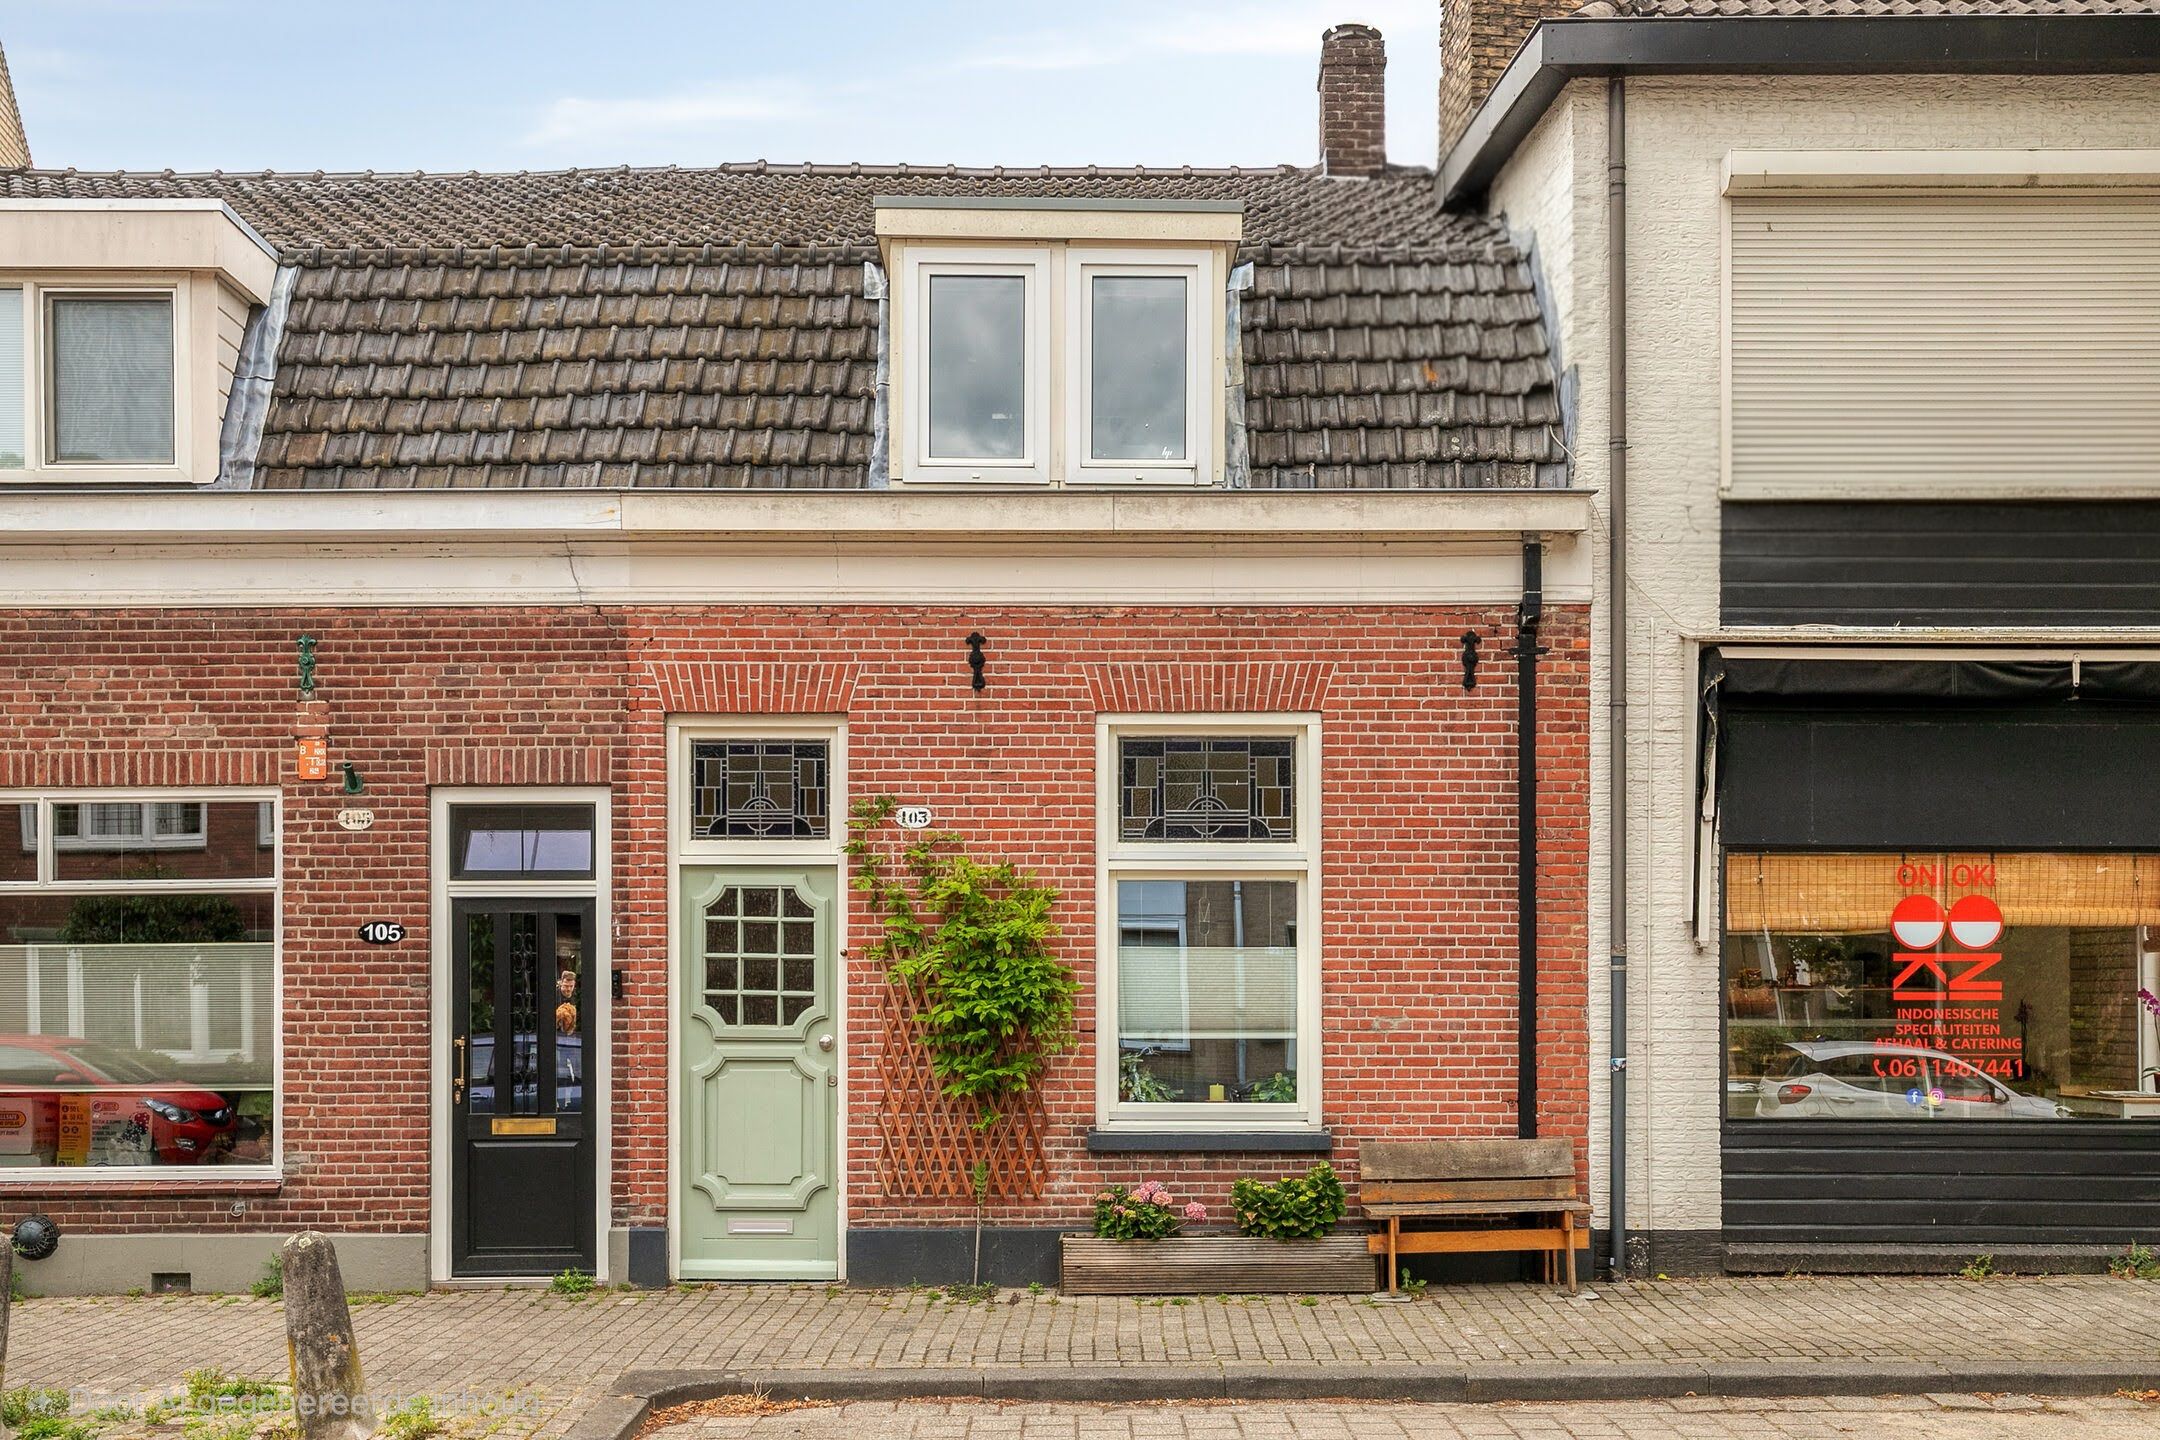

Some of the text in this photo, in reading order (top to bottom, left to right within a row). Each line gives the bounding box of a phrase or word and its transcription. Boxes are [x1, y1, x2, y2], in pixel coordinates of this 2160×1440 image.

[902, 811, 928, 823] 103
[1897, 864, 1945, 887] ONI
[363, 923, 401, 942] 105
[1897, 1008, 1999, 1020] INDONESISCHE
[1895, 1024, 2000, 1035] SPECIALITEITEN
[1874, 1038, 2022, 1050] AFHAAL & CATERING
[1889, 1058, 2023, 1078] 0611467441
